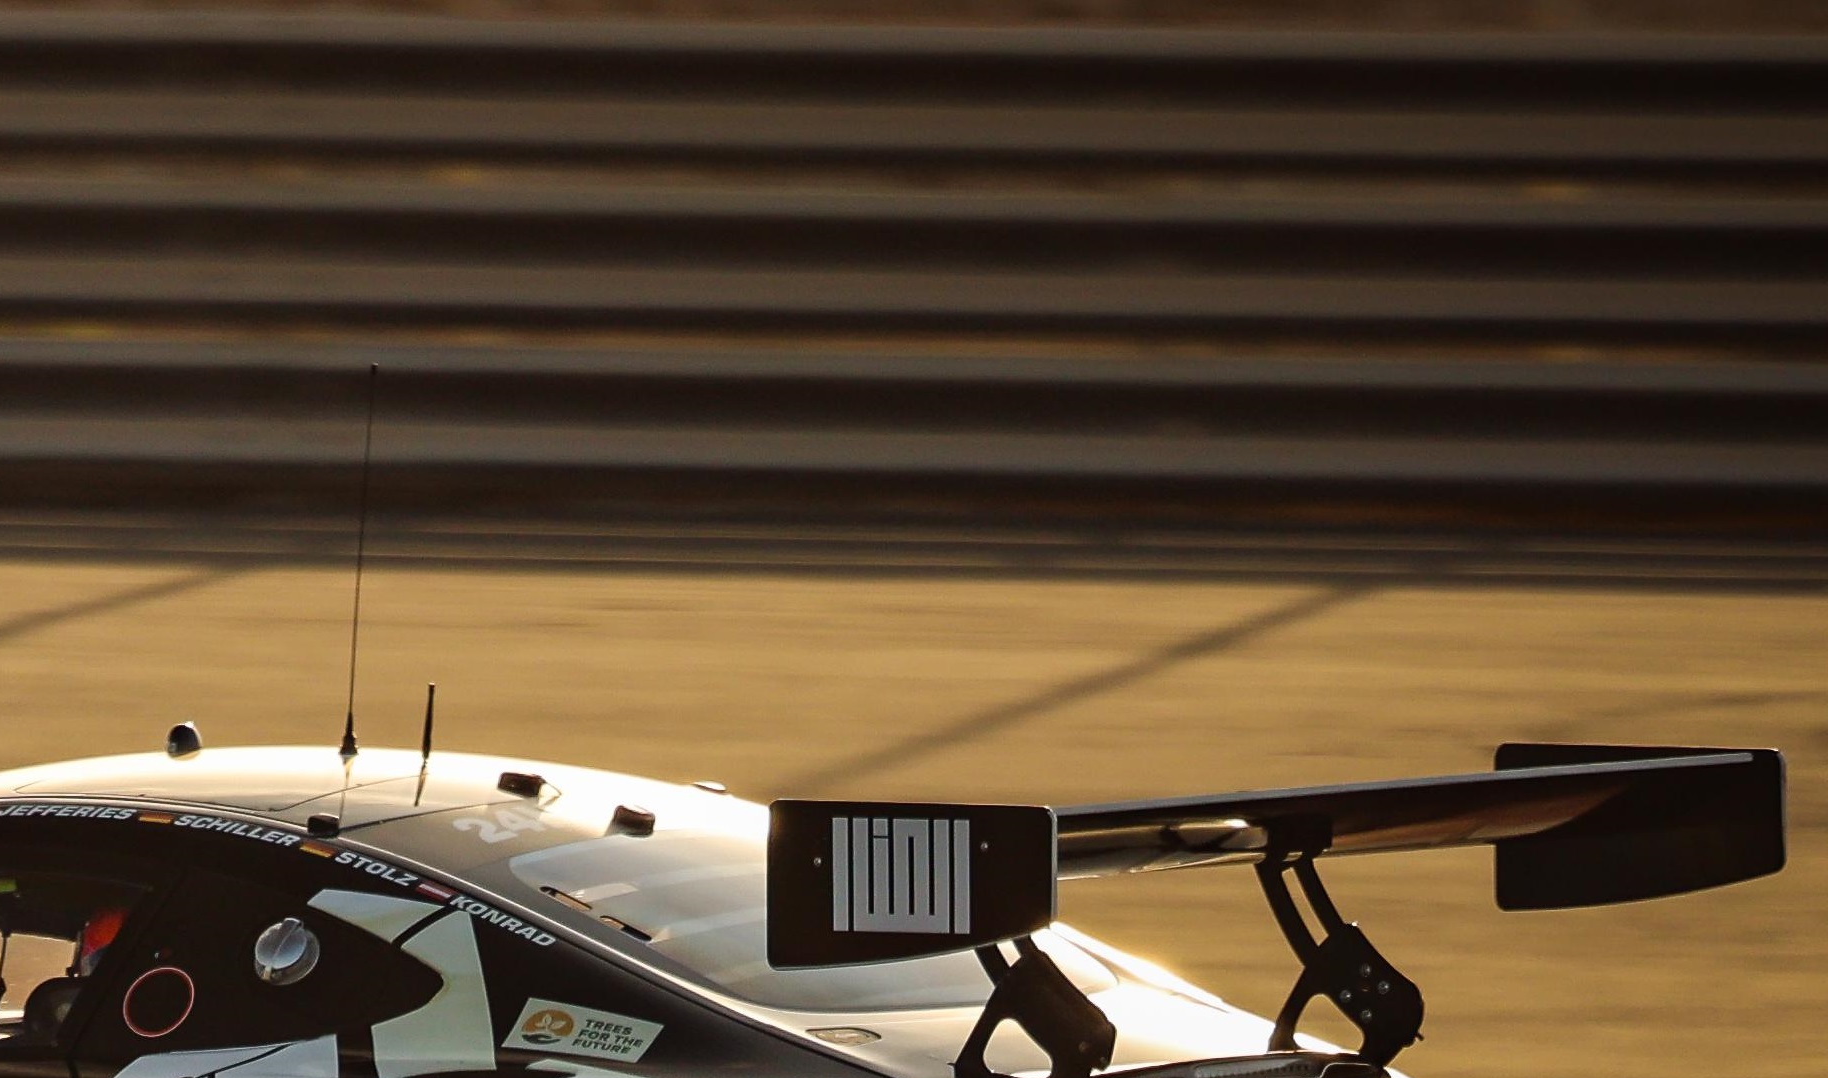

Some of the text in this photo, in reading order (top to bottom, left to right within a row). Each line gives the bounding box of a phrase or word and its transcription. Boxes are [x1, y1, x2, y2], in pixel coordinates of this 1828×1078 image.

[174, 814, 301, 848] SCHILLER
[334, 851, 422, 888] STOLZ
[449, 895, 559, 948] KONRAD
[585, 1018, 633, 1036] TREES
[571, 1038, 632, 1054] FUTURE
[577, 1029, 644, 1048] FOR THE
